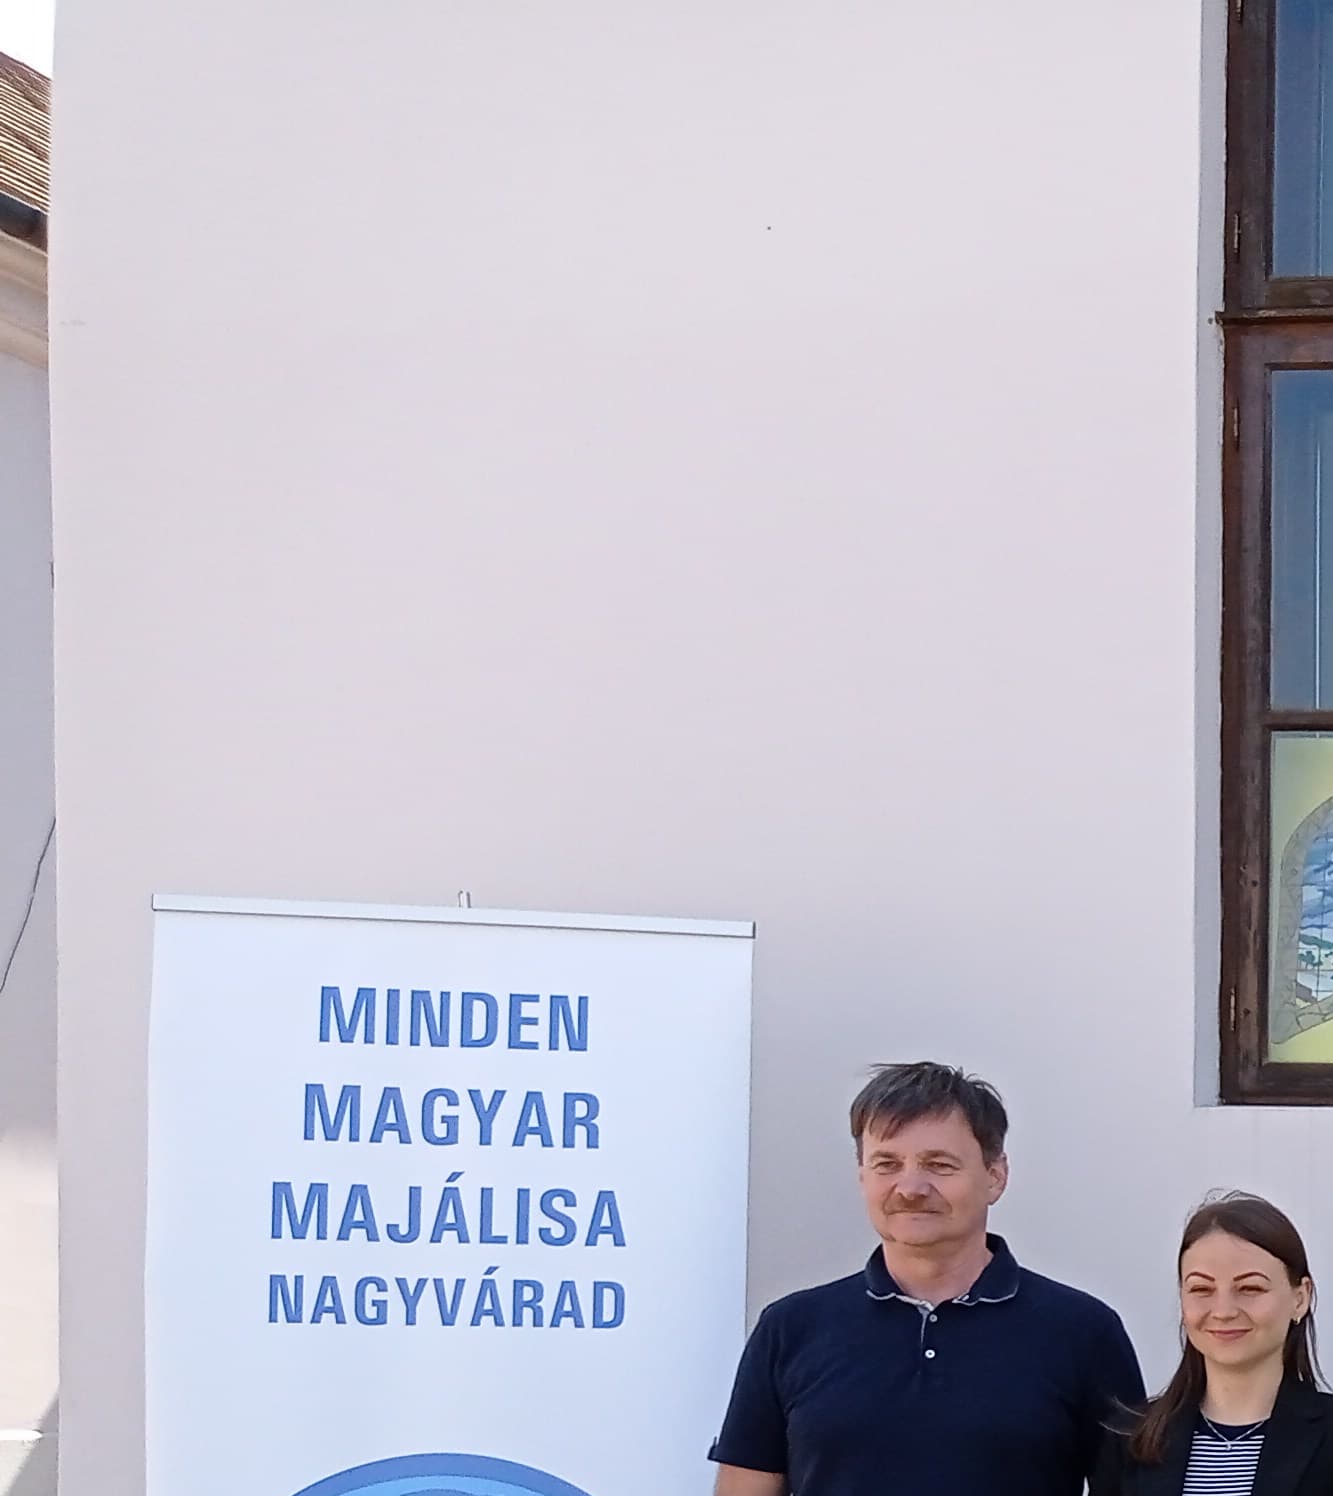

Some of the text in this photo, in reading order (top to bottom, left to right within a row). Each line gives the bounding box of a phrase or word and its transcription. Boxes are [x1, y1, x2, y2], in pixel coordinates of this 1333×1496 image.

[318, 985, 590, 1052] MINDEN
[303, 1082, 602, 1150] MAGYAR
[270, 1170, 628, 1248] MAJÁLISA
[267, 1265, 628, 1330] NAGYVÁRAD
